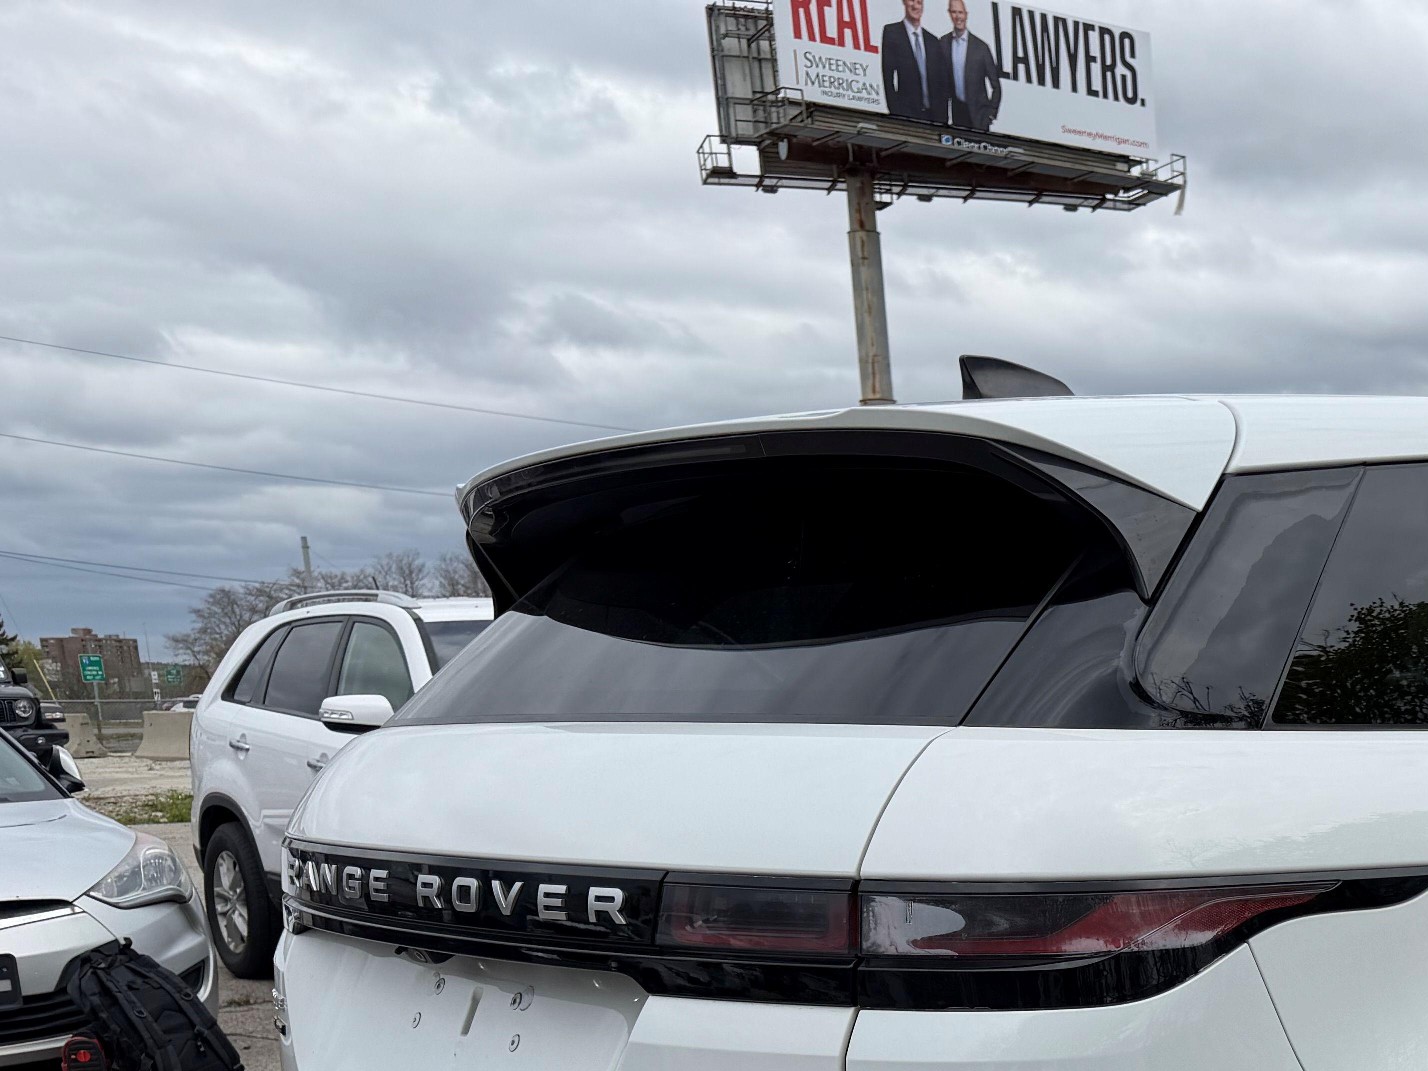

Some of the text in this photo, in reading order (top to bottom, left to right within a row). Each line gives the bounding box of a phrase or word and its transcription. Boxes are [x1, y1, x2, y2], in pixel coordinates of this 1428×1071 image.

[803, 51, 869, 77] SWEENEY
[804, 70, 880, 97] MERRIGAN
[288, 856, 628, 925] RANGE ROVER
